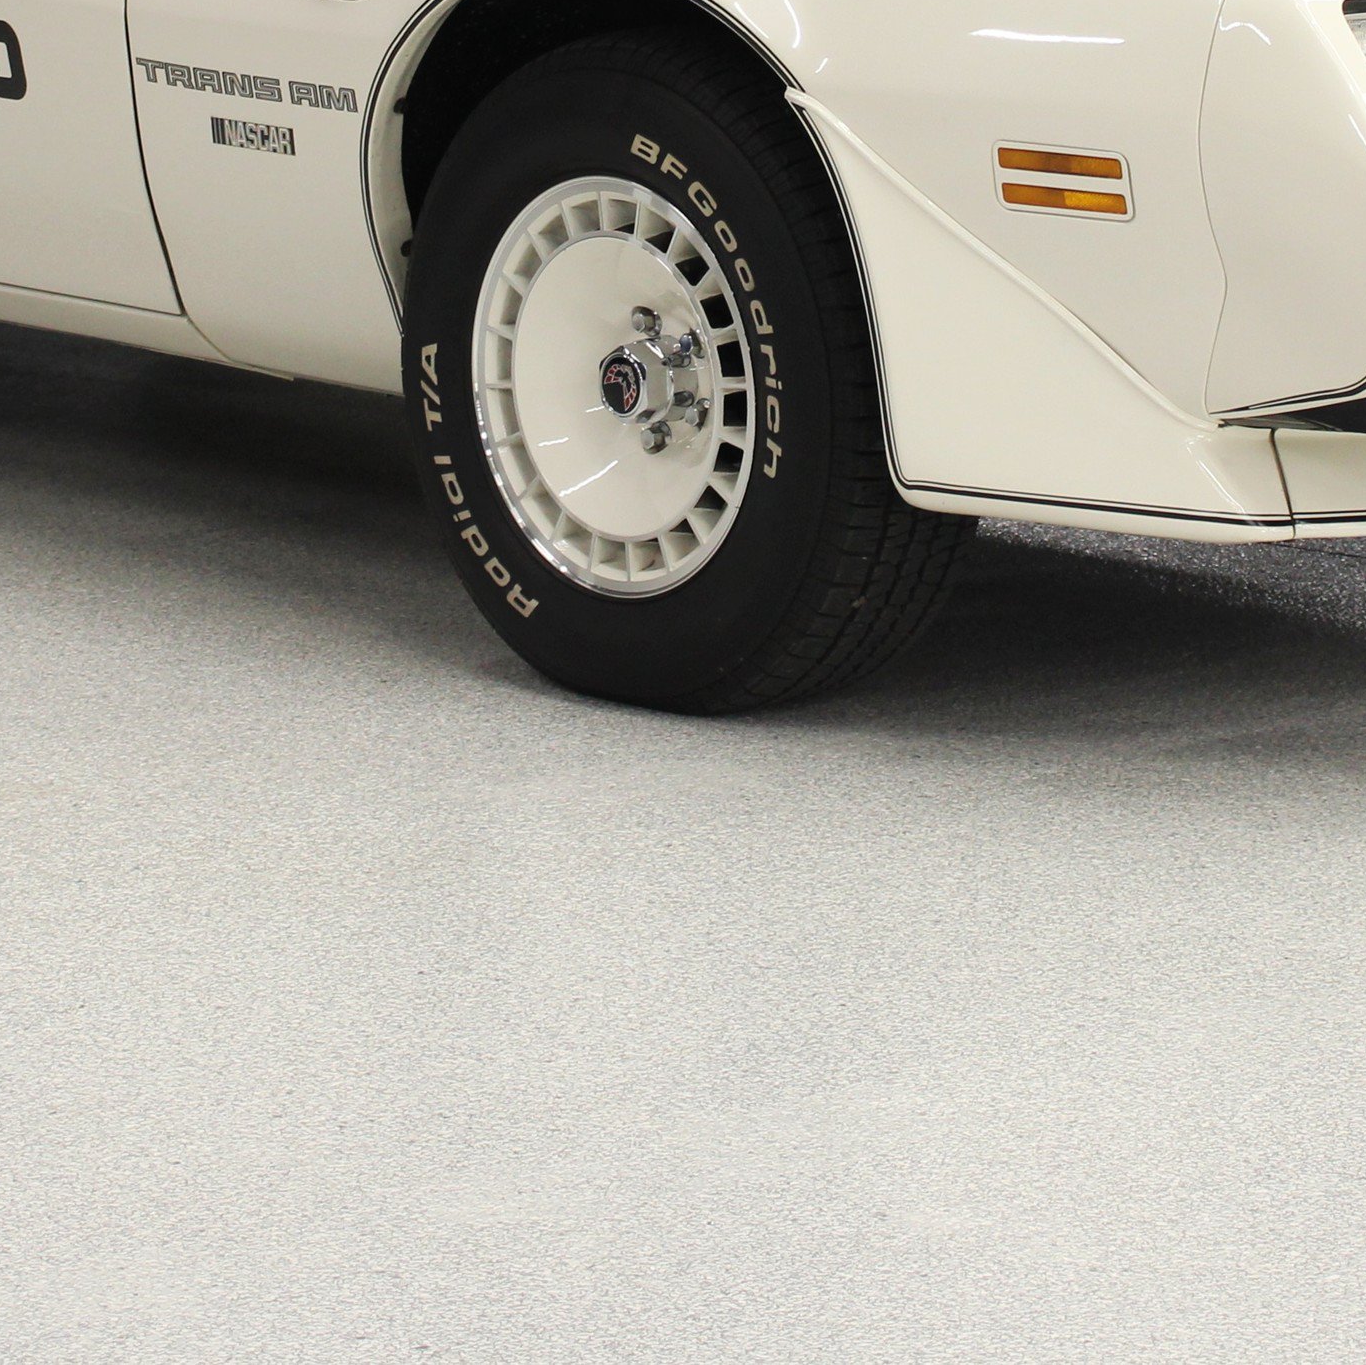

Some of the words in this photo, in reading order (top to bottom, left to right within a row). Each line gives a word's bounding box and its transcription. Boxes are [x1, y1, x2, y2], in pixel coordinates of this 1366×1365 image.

[135, 57, 283, 102] TRANS
[288, 80, 359, 113] AM
[220, 118, 295, 156] NASCAR
[630, 134, 784, 479] BFGoodrich
[421, 342, 444, 432] T/A
[434, 454, 540, 618] Radial
